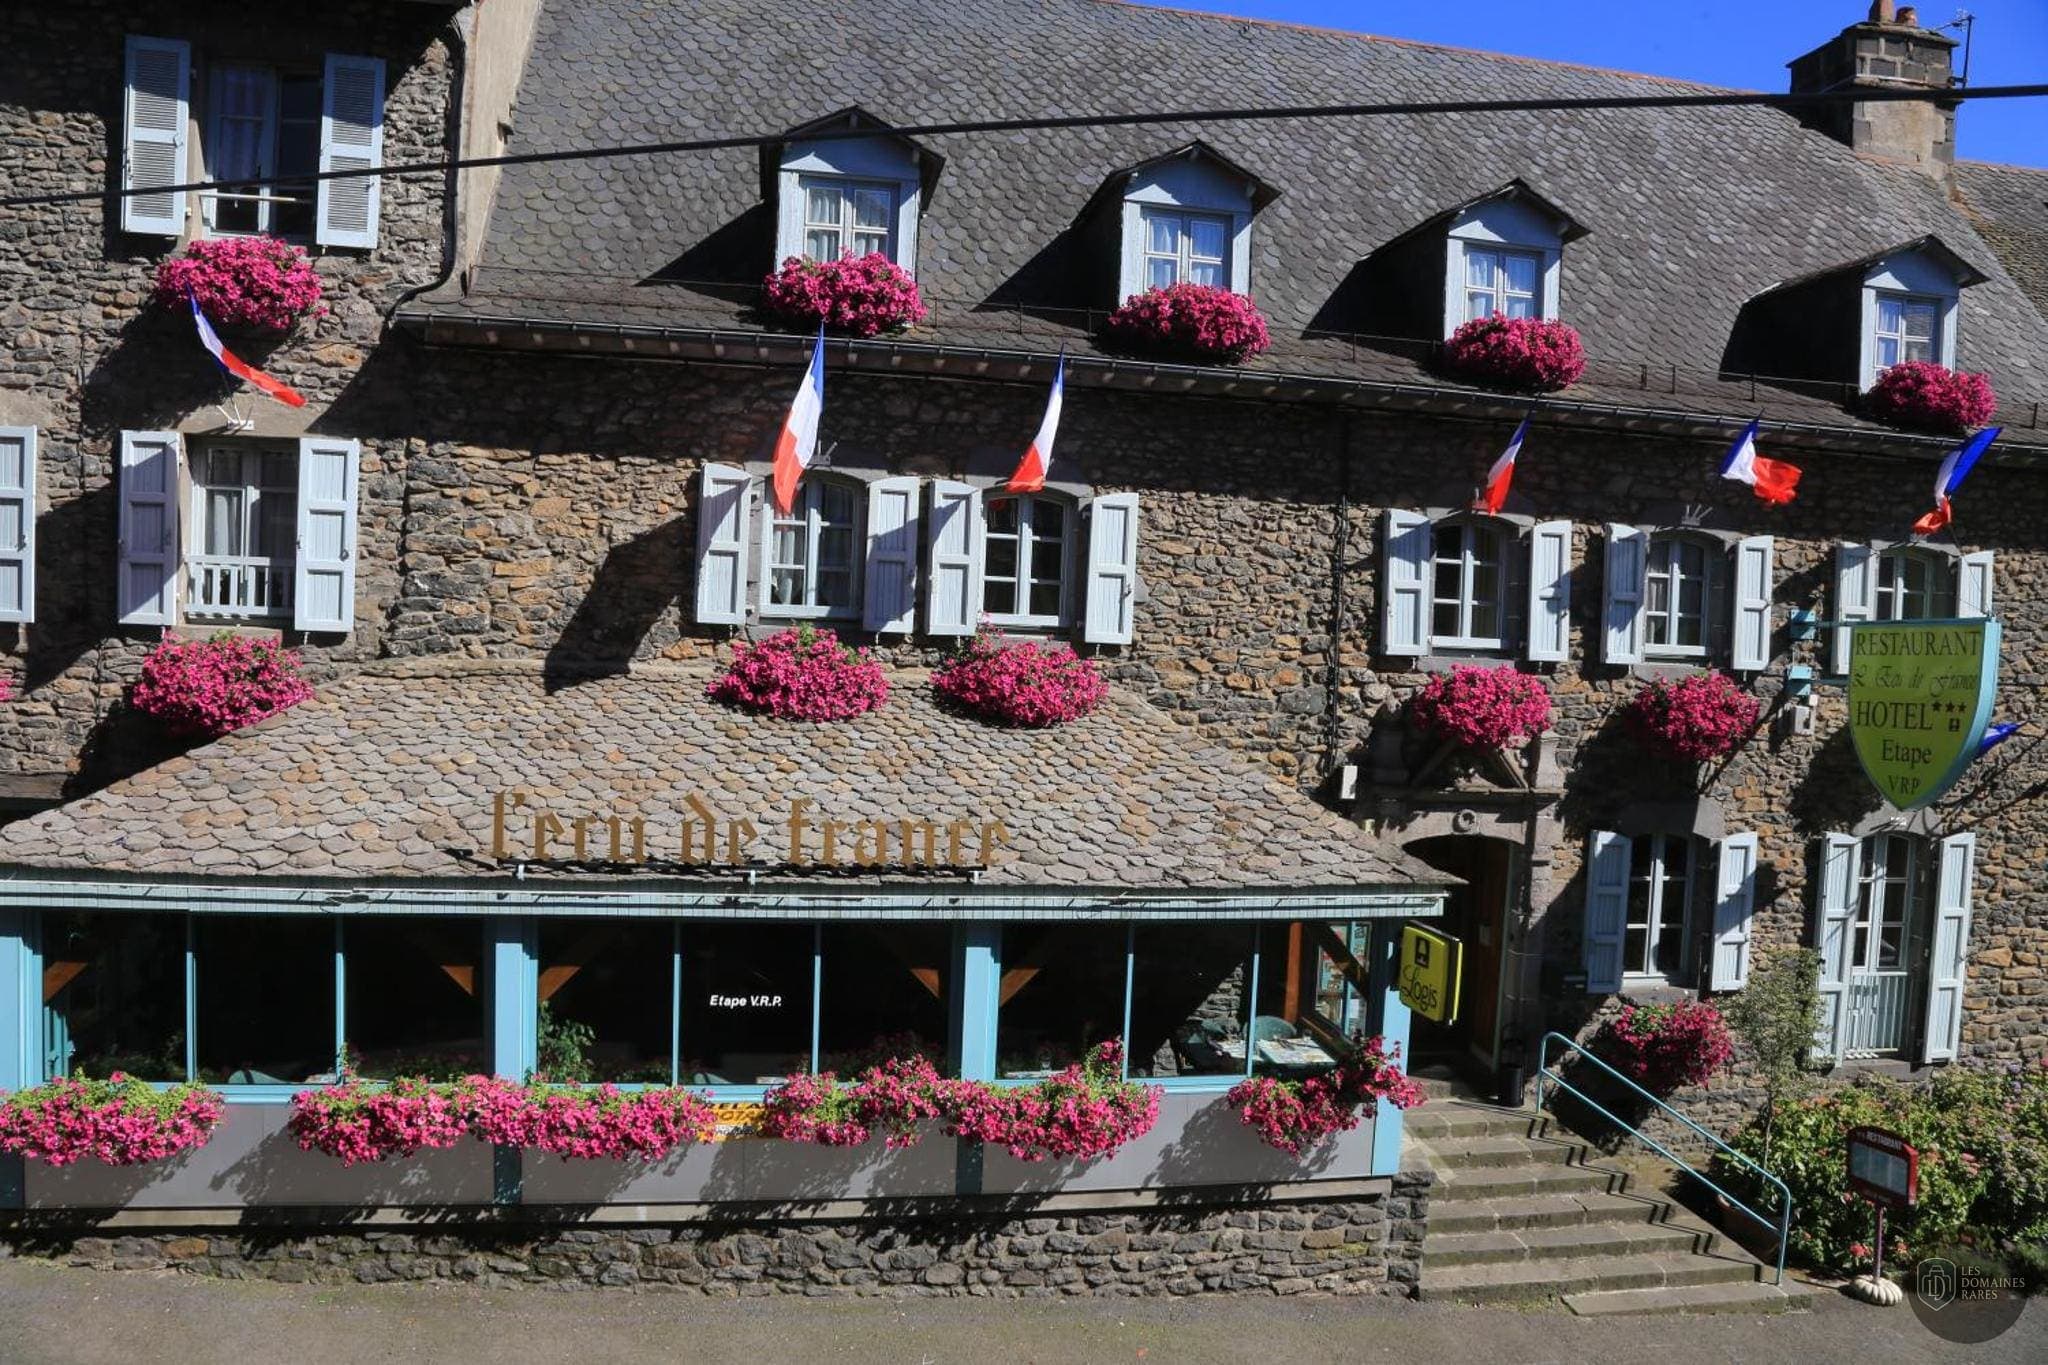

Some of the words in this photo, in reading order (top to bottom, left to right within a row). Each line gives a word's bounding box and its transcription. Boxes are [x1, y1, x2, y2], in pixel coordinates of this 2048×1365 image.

[1856, 631, 1981, 656] RESTAURANT
[1856, 701, 1933, 730] HOTEL
[1882, 739, 1932, 768] Etape
[1888, 775, 1920, 795] VRP
[680, 792, 759, 865] de
[709, 995, 747, 1009] Etape
[750, 995, 782, 1007] V.R.P.
[1400, 964, 1438, 1012] Logis
